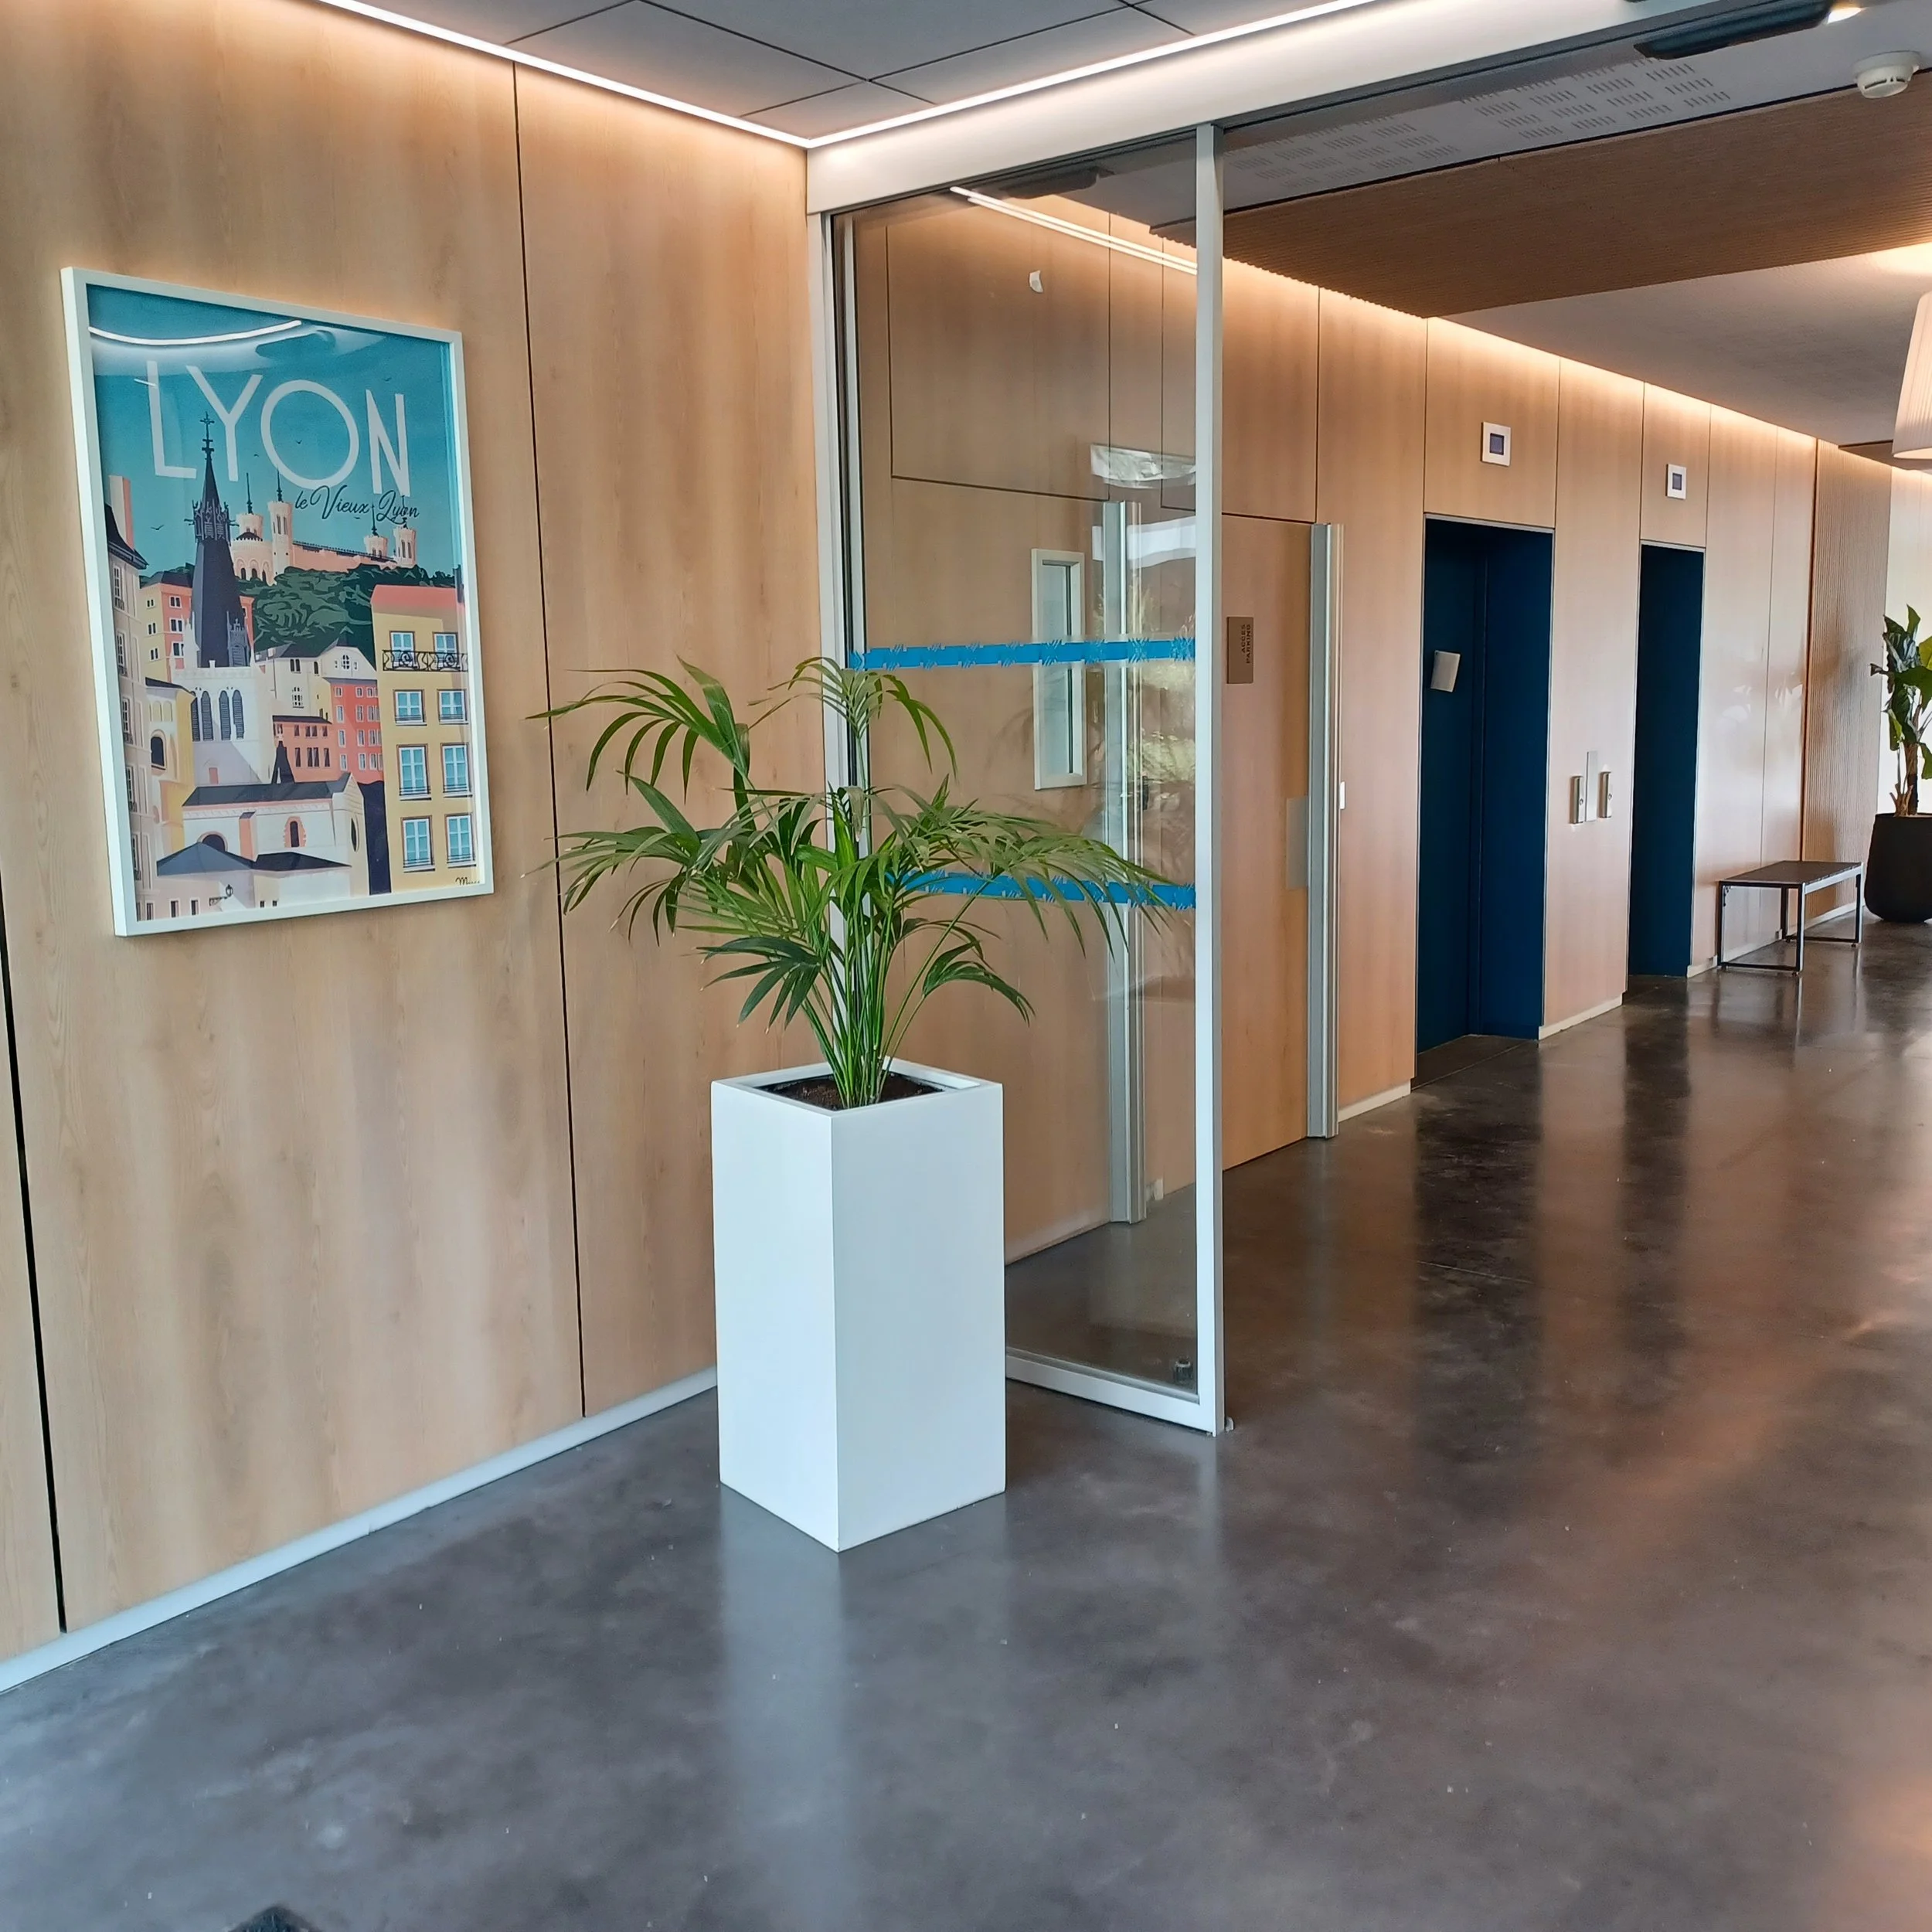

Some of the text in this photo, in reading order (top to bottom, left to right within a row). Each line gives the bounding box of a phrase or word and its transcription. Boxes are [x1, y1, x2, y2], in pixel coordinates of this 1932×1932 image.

[146, 360, 410, 497] LYON
[294, 485, 420, 525] le Vieux Lyon
